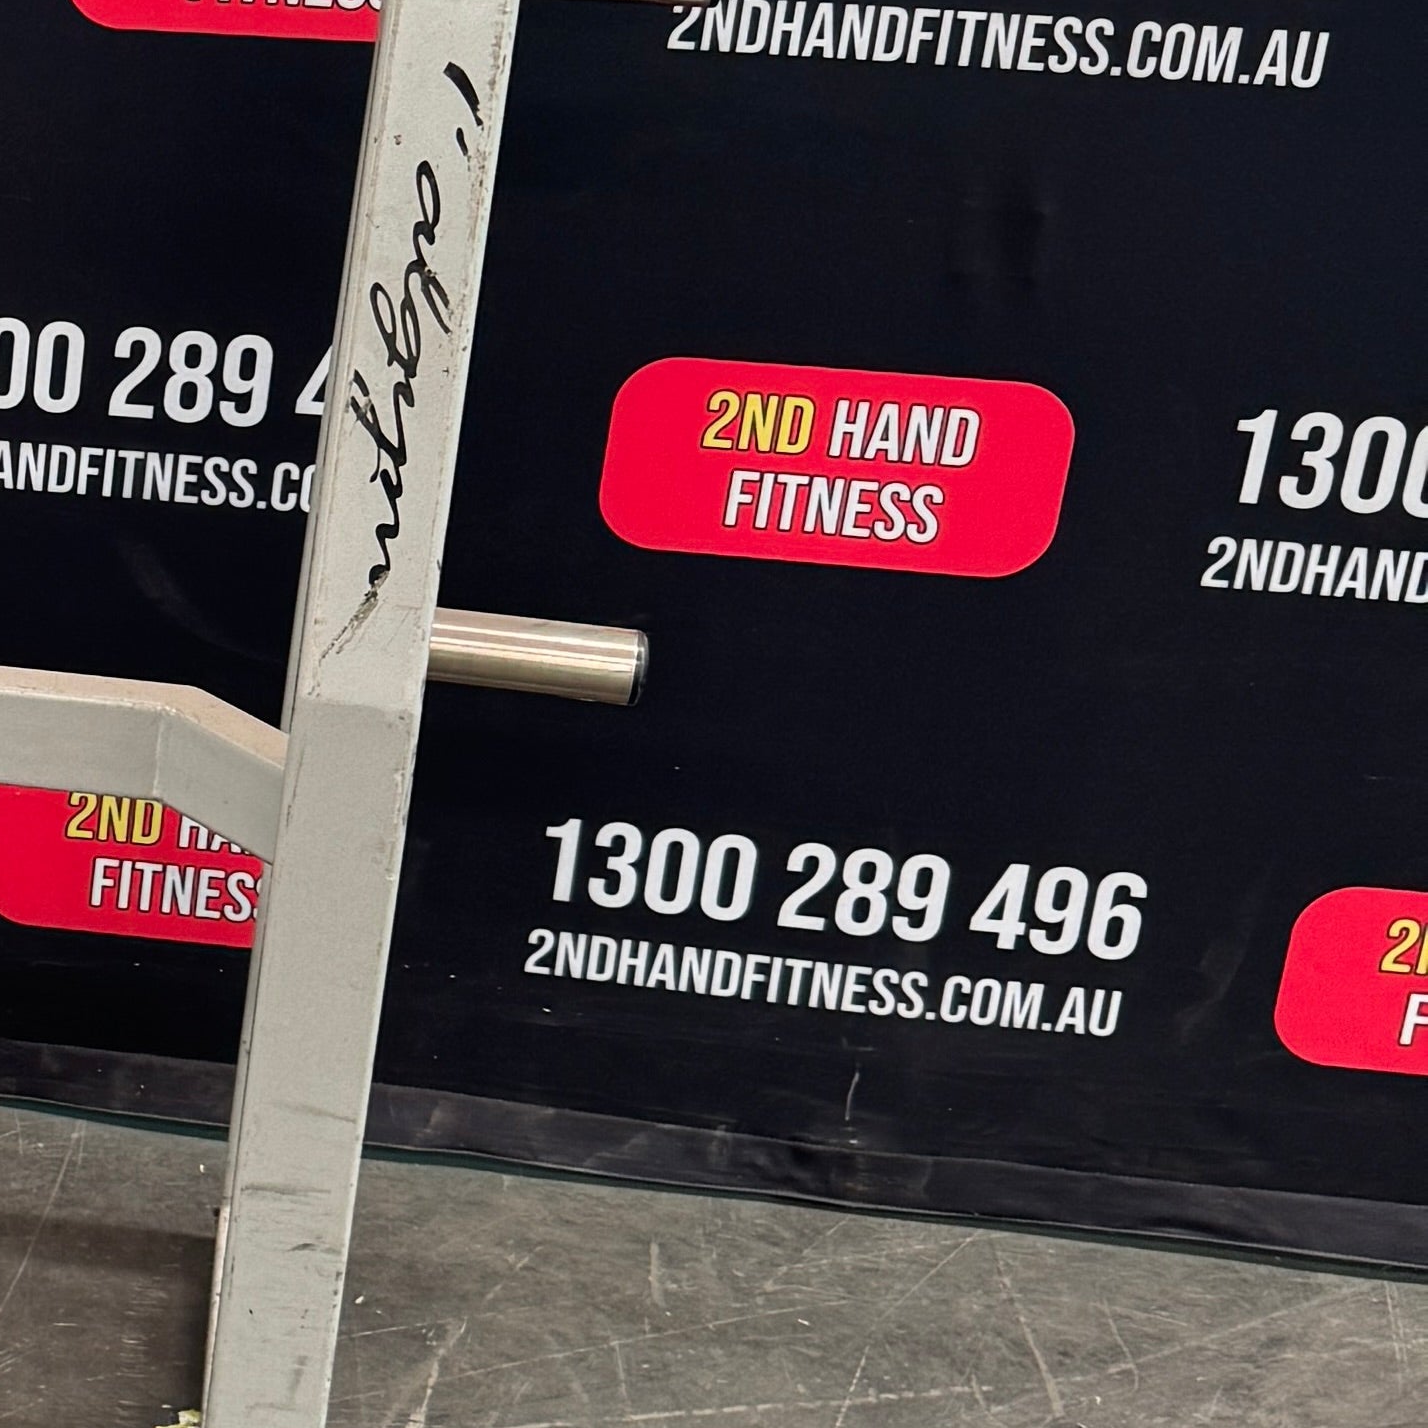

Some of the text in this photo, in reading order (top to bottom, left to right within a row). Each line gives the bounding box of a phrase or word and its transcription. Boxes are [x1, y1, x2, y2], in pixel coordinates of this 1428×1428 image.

[107, 325, 275, 429] 289
[701, 389, 981, 467] 2ND HAND
[723, 469, 945, 544] FITNESS
[63, 790, 164, 846] 2ND
[89, 857, 262, 923] FITNES
[544, 817, 1149, 962] 1300 289 496
[523, 928, 1123, 1038] 2NDHANDFITNESS.COM.AU
